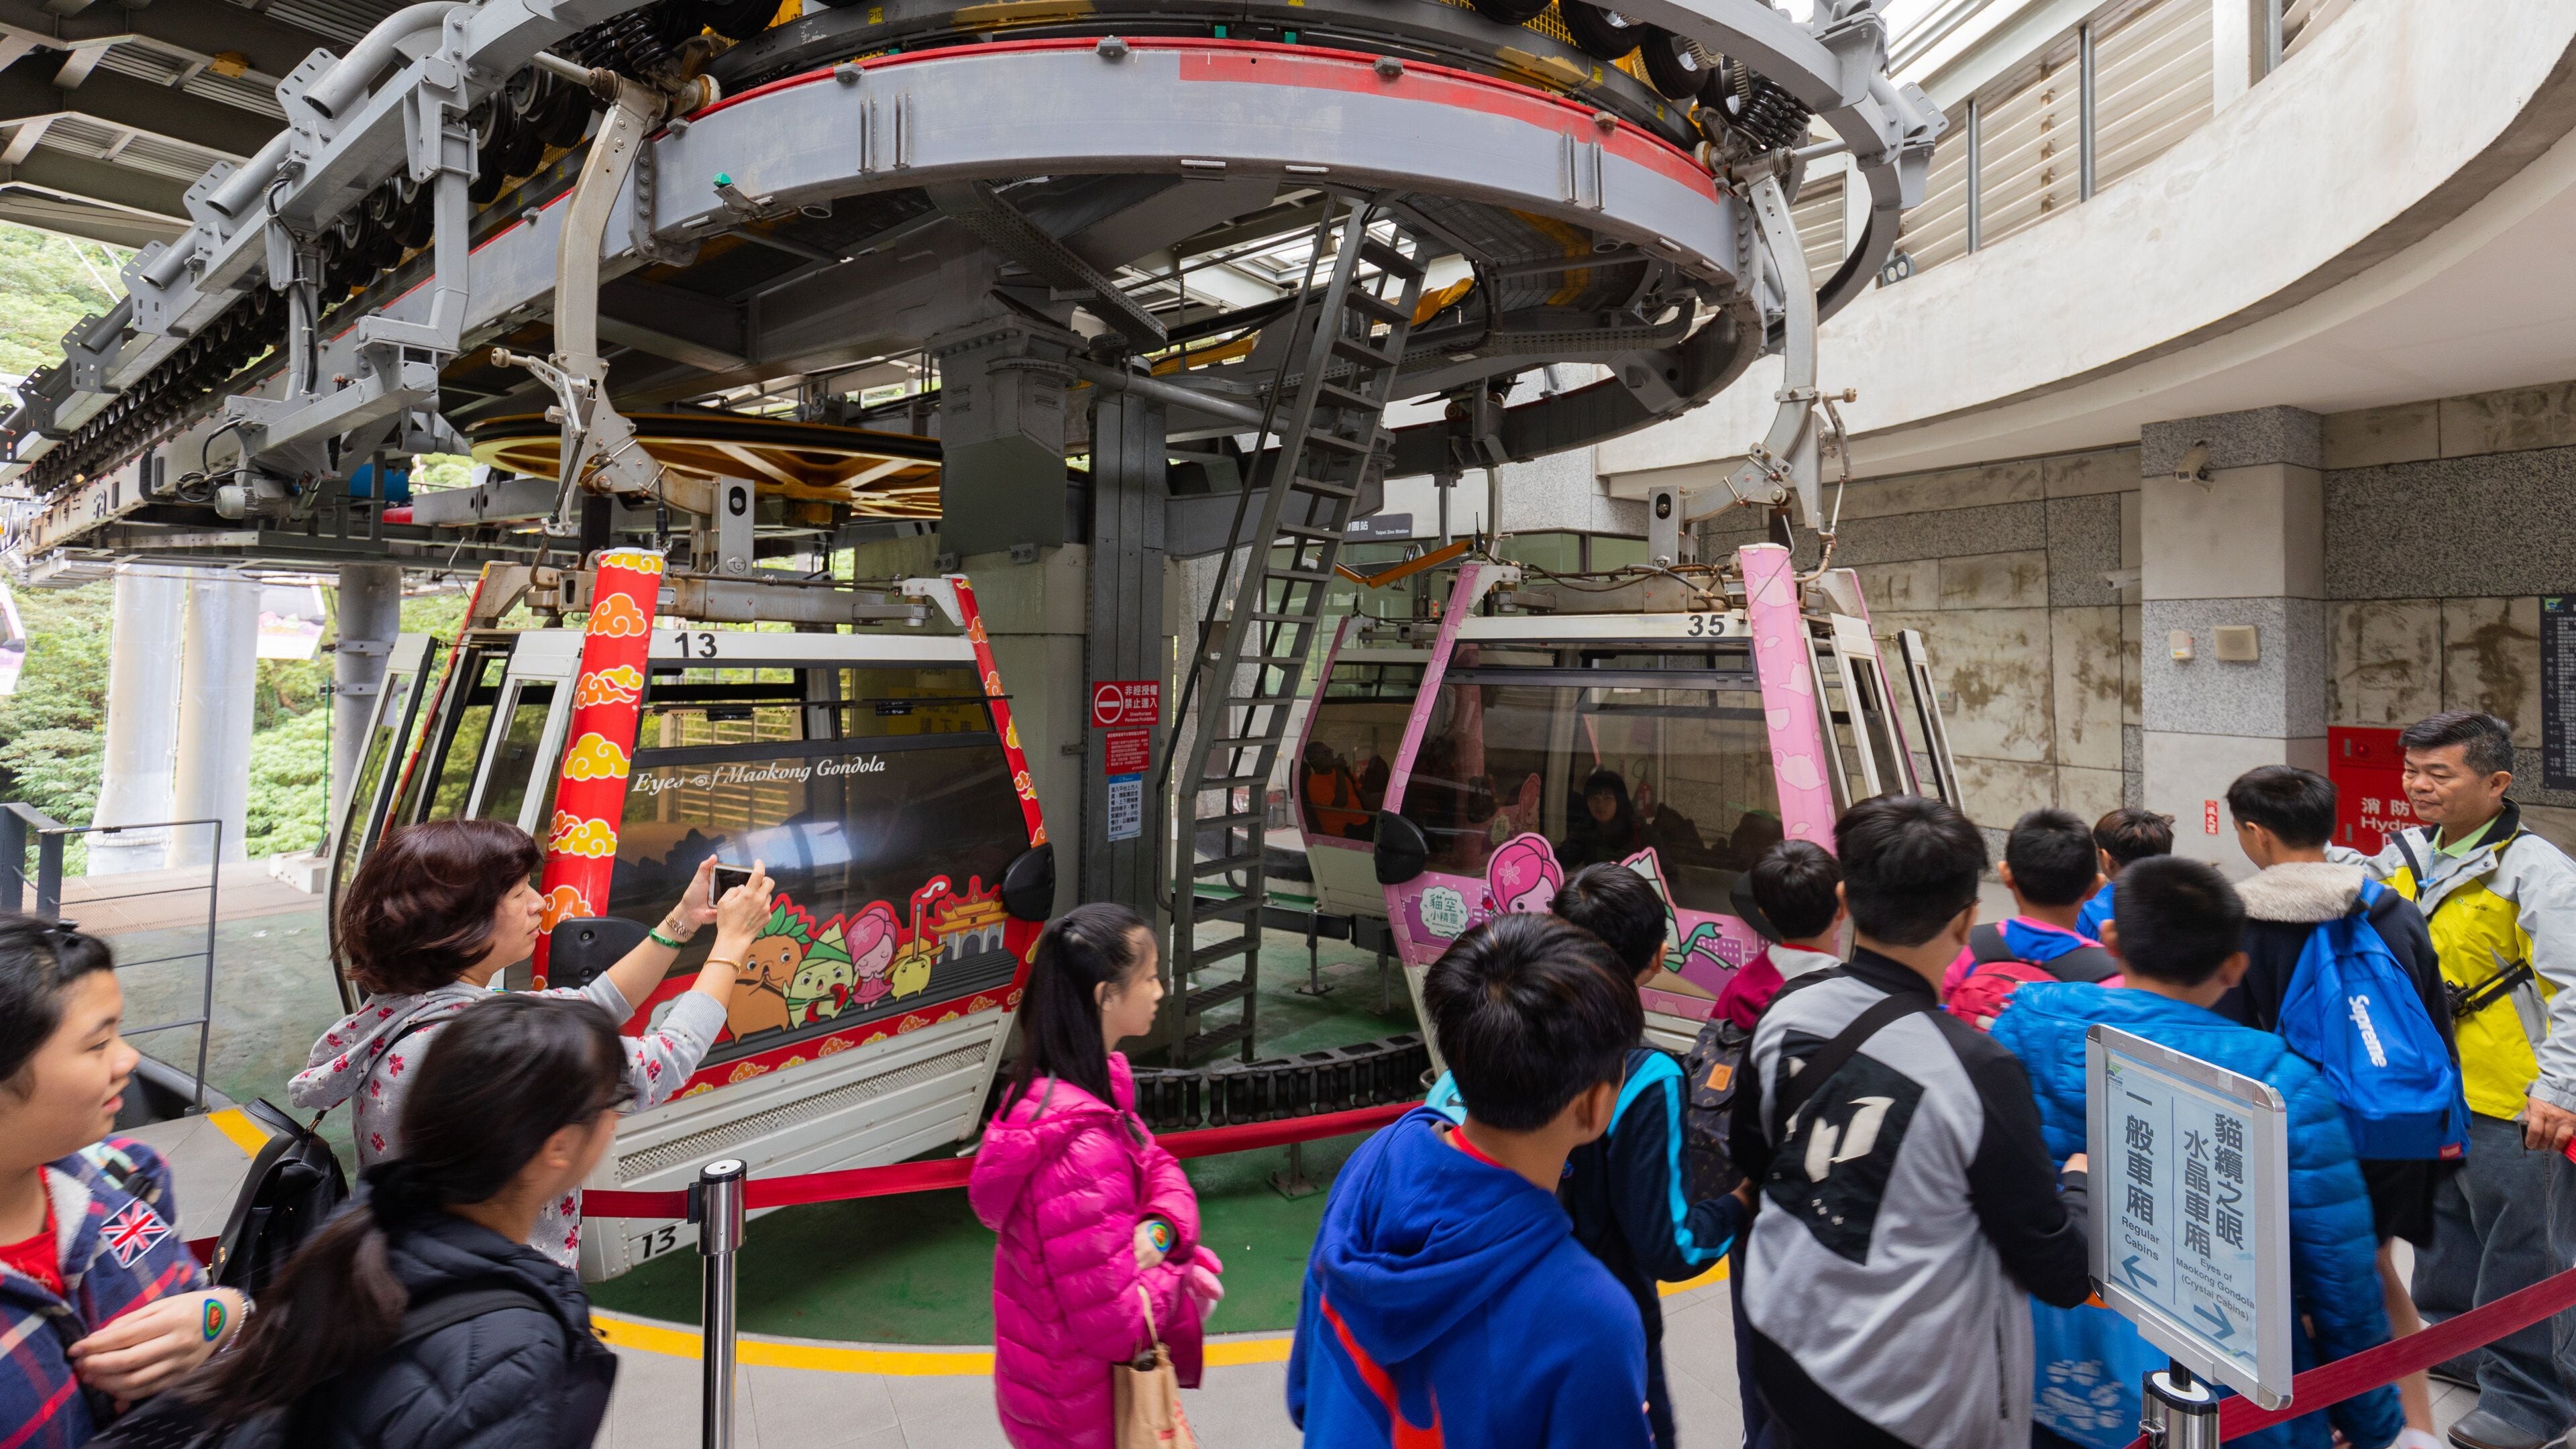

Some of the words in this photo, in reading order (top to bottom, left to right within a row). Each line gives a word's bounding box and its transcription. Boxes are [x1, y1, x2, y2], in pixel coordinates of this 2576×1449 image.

[869, 11, 881, 20] P10
[1687, 614, 1725, 636] 35
[675, 633, 717, 658] 13
[1124, 685, 1158, 696] 非經授權
[1124, 698, 1158, 708] 禁止進入
[631, 773, 685, 796] Eyes
[723, 762, 812, 784] Maokong
[816, 756, 885, 777] Gondola
[2361, 797, 2410, 816] 消防
[2361, 816, 2431, 833] Hydr
[1430, 894, 1457, 912] 貓空
[1430, 911, 1458, 924] 小精靈
[2349, 995, 2387, 1068] Supreme
[2125, 1091, 2154, 1226] 一般車廂
[2214, 1113, 2244, 1250] 貓纜之眼
[2184, 1130, 2211, 1259] 水晶車廂
[642, 1226, 676, 1258] 13
[2122, 1216, 2159, 1244] Regular
[2125, 1234, 2159, 1260] Cabins
[2200, 1258, 2221, 1276] Eyes
[2224, 1273, 2233, 1282] of
[2176, 1257, 2214, 1287] Maokong
[2217, 1281, 2255, 1309] Gondola
[2182, 1275, 2214, 1299] (Crystal
[2216, 1295, 2249, 1322] Cabins)
